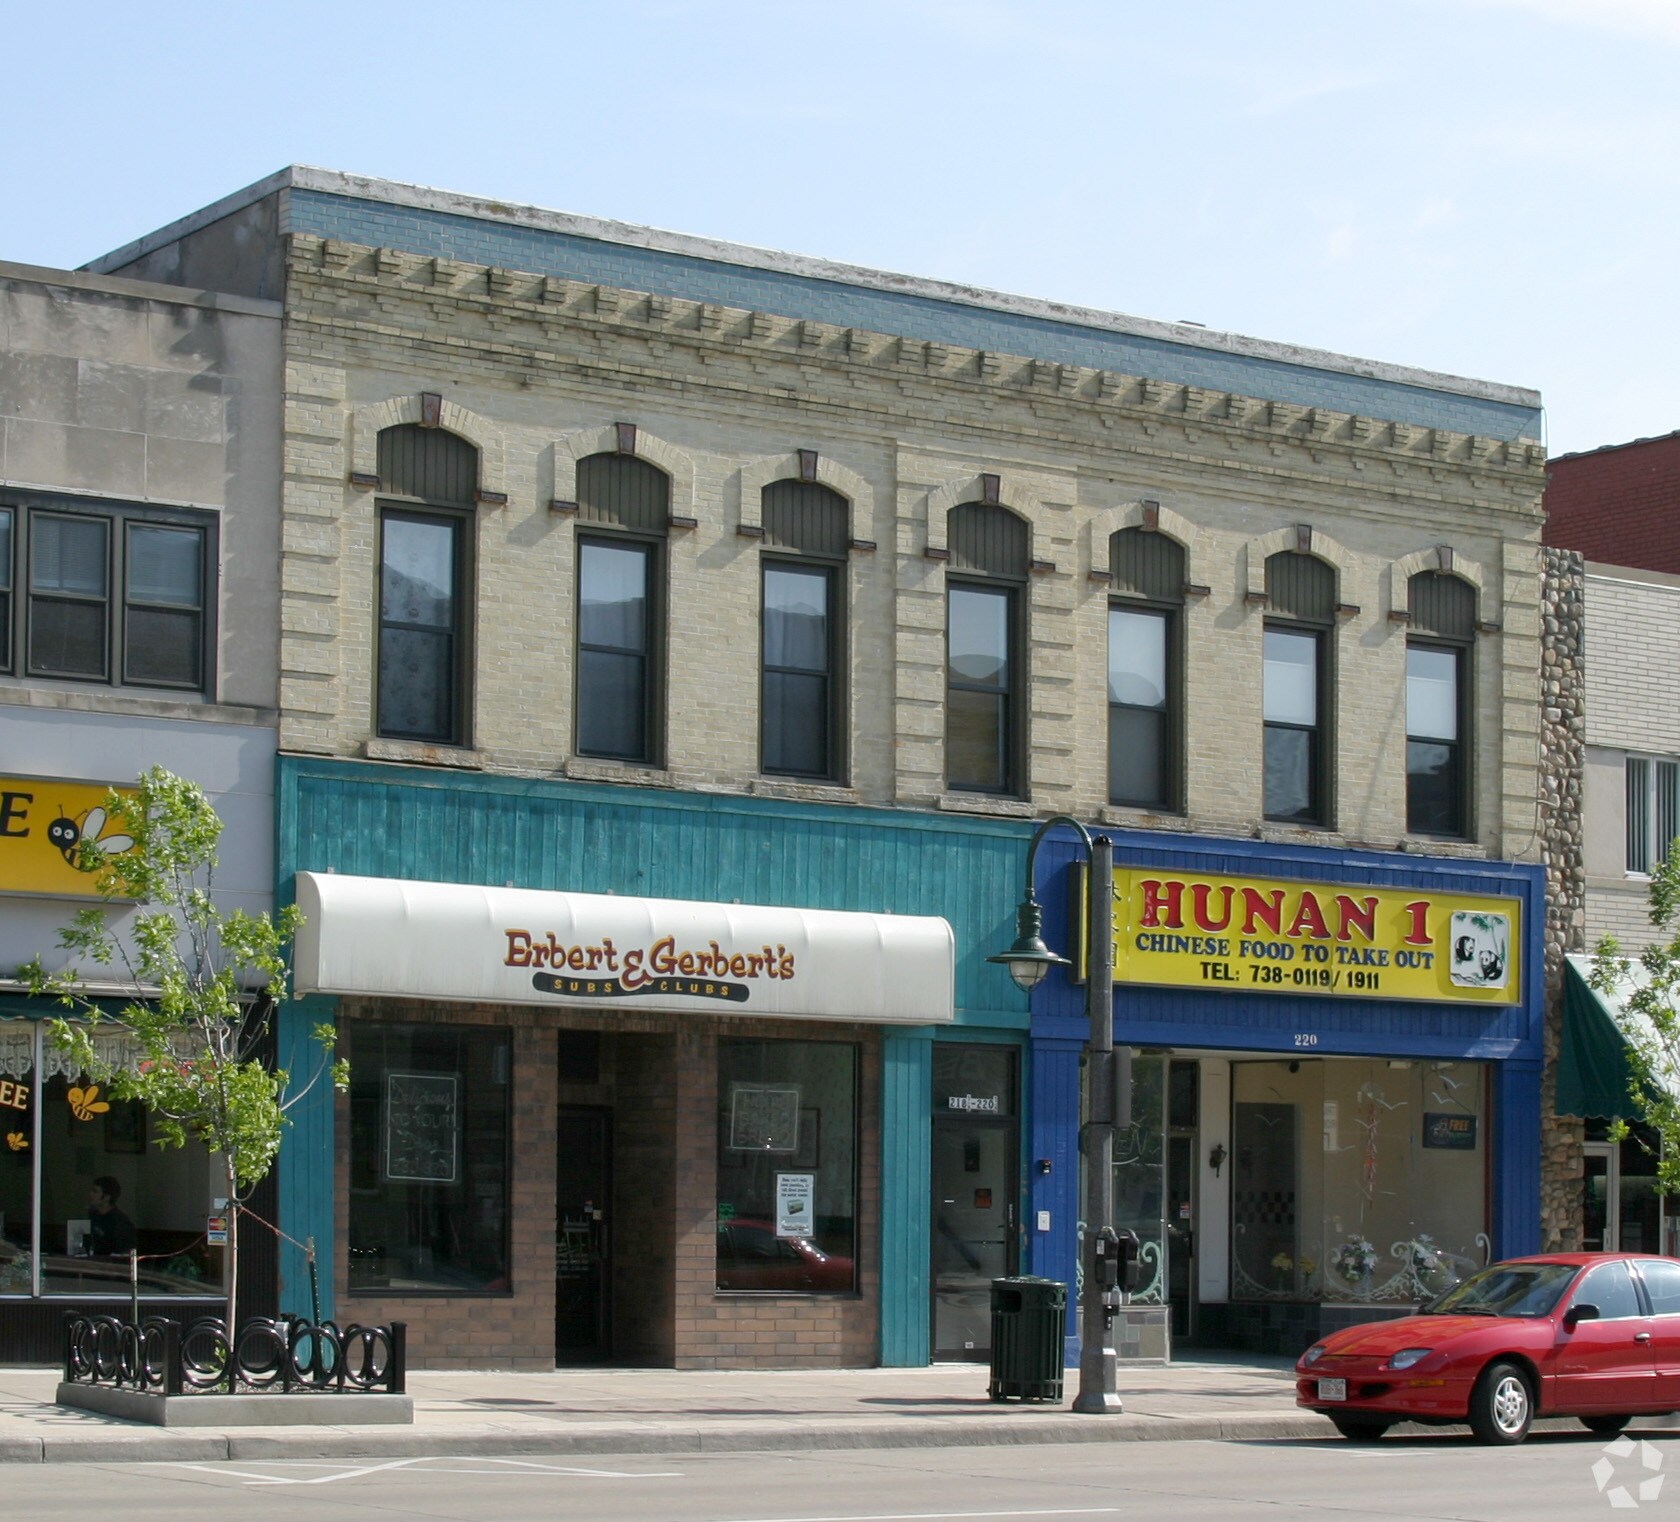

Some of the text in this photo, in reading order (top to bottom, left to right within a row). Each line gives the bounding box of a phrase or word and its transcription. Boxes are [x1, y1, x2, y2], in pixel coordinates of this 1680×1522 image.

[0, 791, 33, 837] E
[1139, 879, 1380, 943] HUNAN
[1404, 901, 1434, 946] 1
[503, 928, 620, 972] Erbert
[650, 934, 796, 981] Gerbert's
[1135, 932, 1435, 970] CHINESE FOOD TO TAKE OUT
[553, 978, 730, 997] SUBS CLUBS
[1199, 961, 1240, 981] TEL:
[1346, 970, 1380, 990] 1911
[1294, 1033, 1318, 1047] 220
